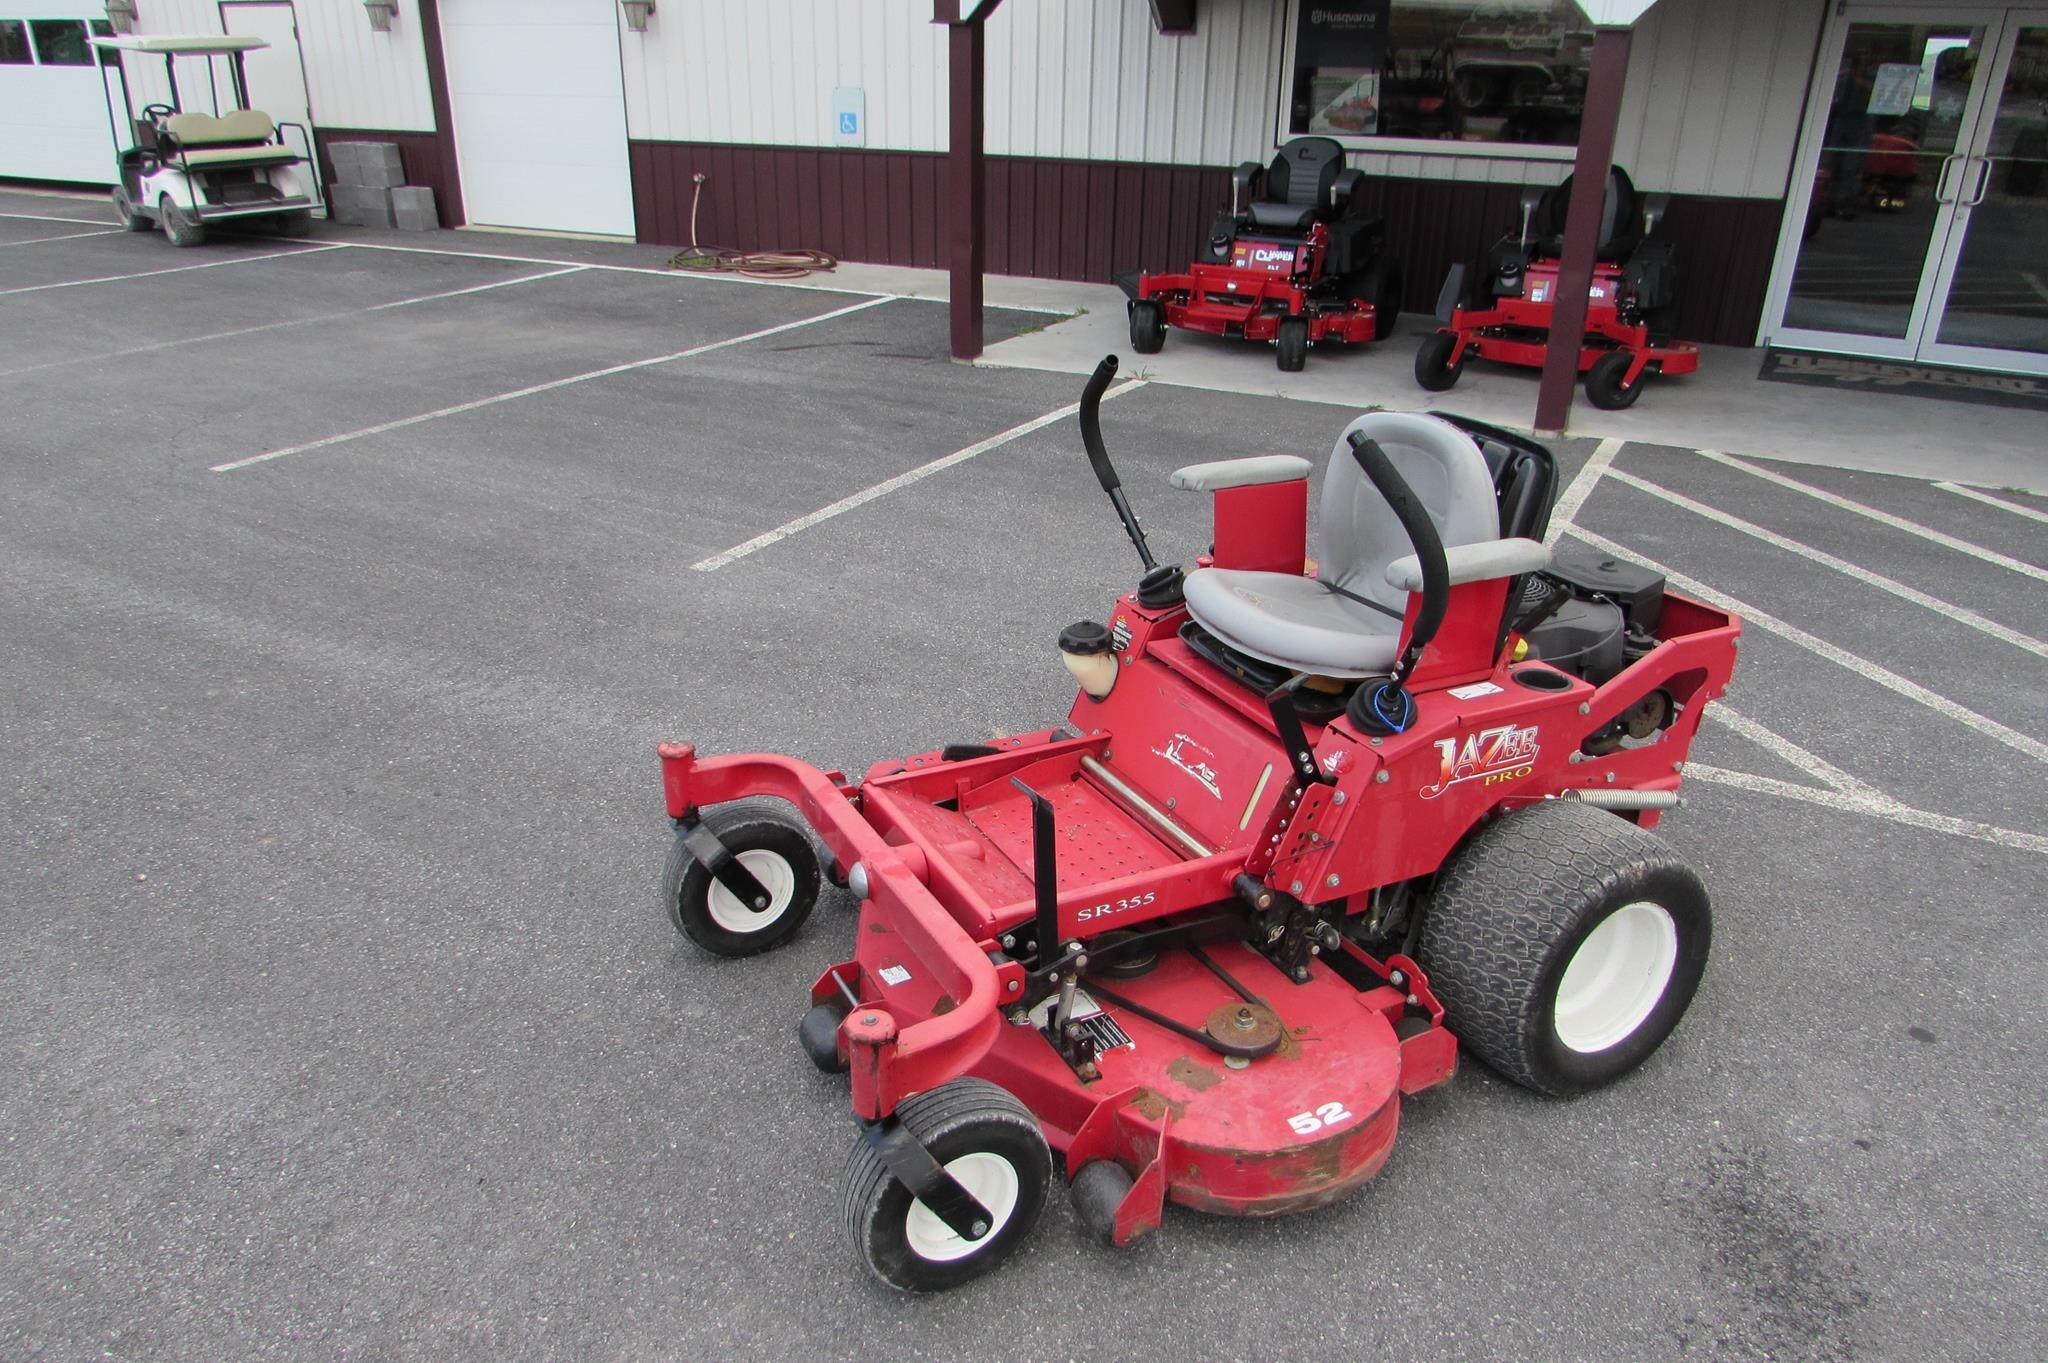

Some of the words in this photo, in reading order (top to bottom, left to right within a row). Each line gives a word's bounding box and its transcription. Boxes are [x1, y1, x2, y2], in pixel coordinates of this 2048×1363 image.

[1322, 10, 1376, 24] Husqvarna
[1484, 766, 1533, 786] PRO
[1287, 1101, 1353, 1135] 52
